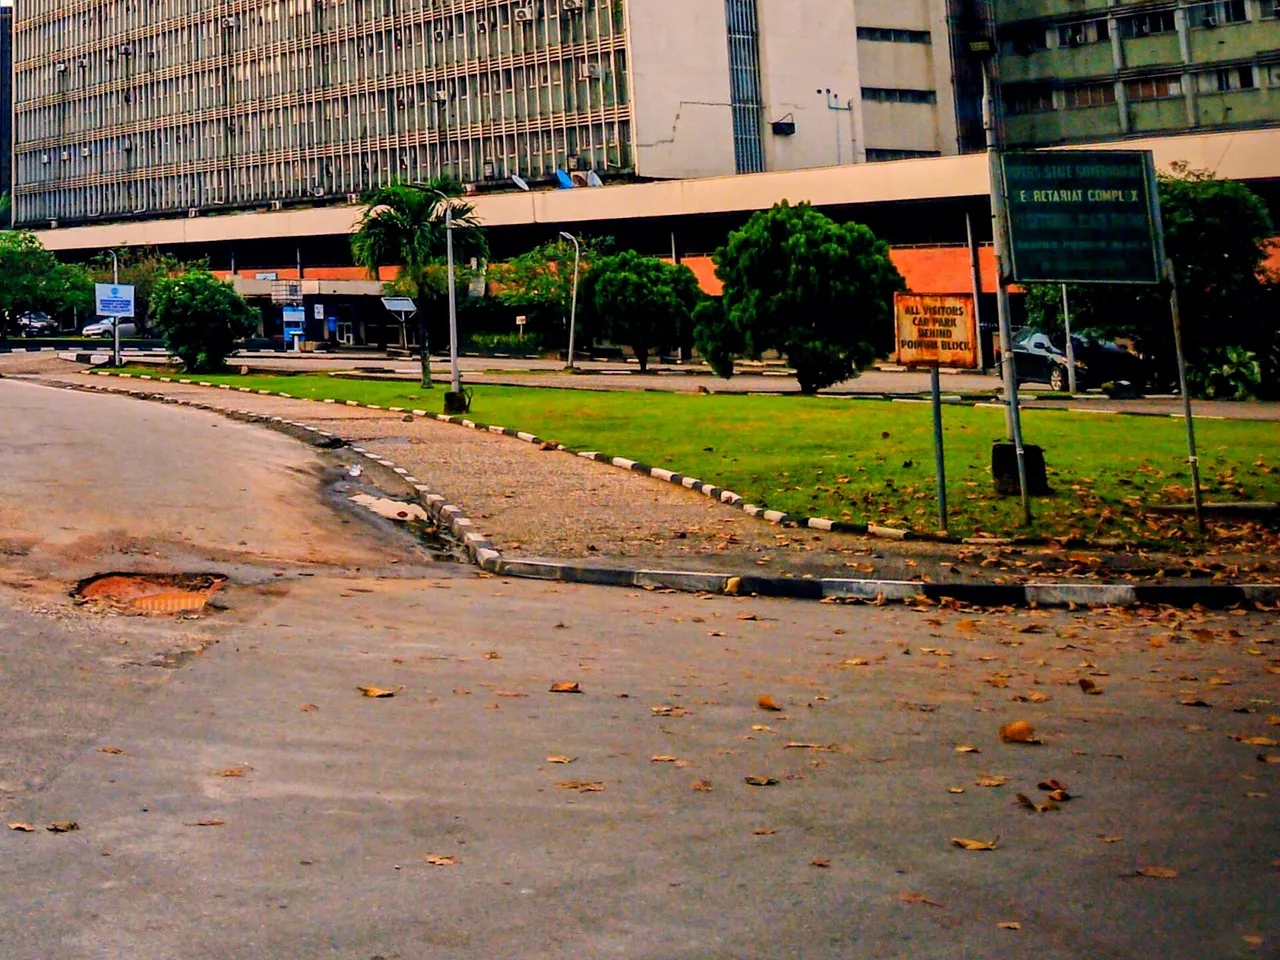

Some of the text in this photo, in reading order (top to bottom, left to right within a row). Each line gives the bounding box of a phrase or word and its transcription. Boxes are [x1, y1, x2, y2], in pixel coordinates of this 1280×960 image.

[1012, 190, 1138, 202] ERETARIAT COMPLX
[905, 306, 963, 316] ALL VISITORS
[912, 317, 957, 327] CAR PARK
[919, 329, 952, 338] BEHIND
[901, 340, 970, 351] PODIUM BLOCK
